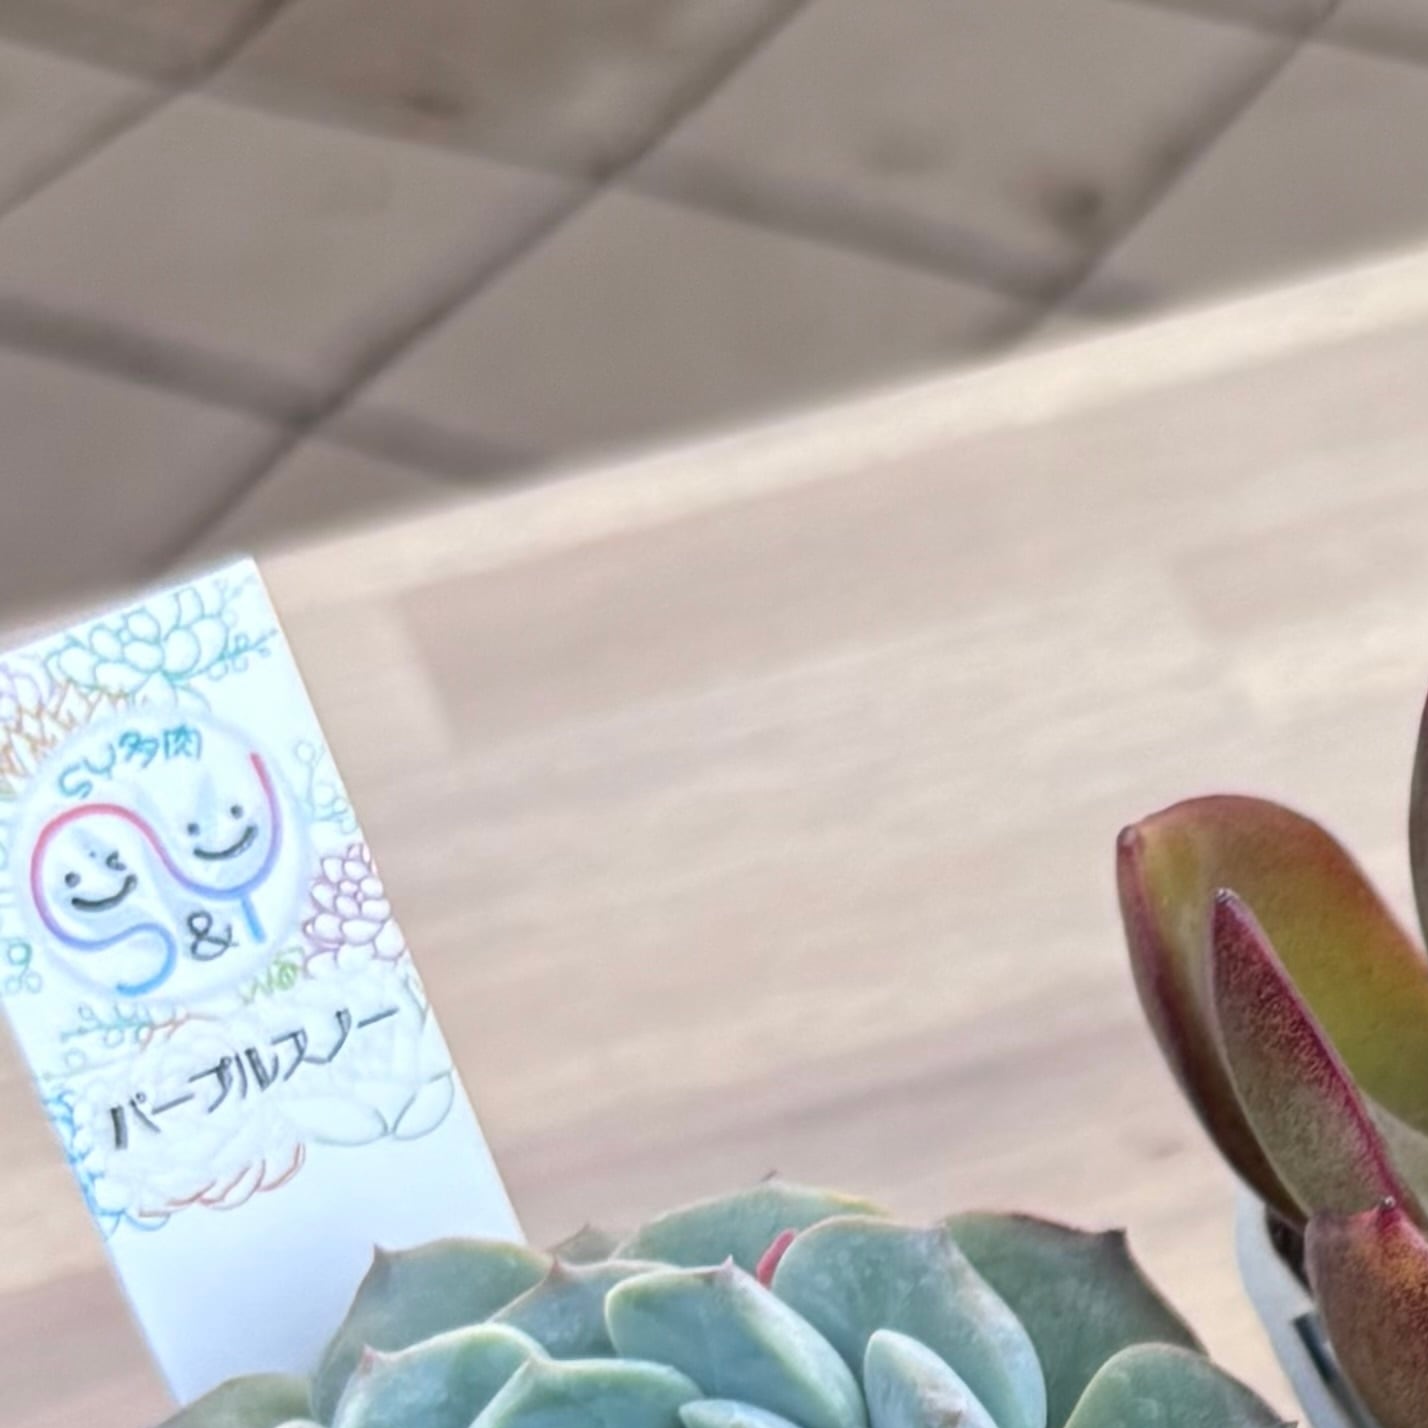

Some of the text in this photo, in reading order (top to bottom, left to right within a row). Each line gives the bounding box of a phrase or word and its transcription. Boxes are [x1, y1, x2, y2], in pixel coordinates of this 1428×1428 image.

[109, 1007, 400, 1148] パープルスノー
